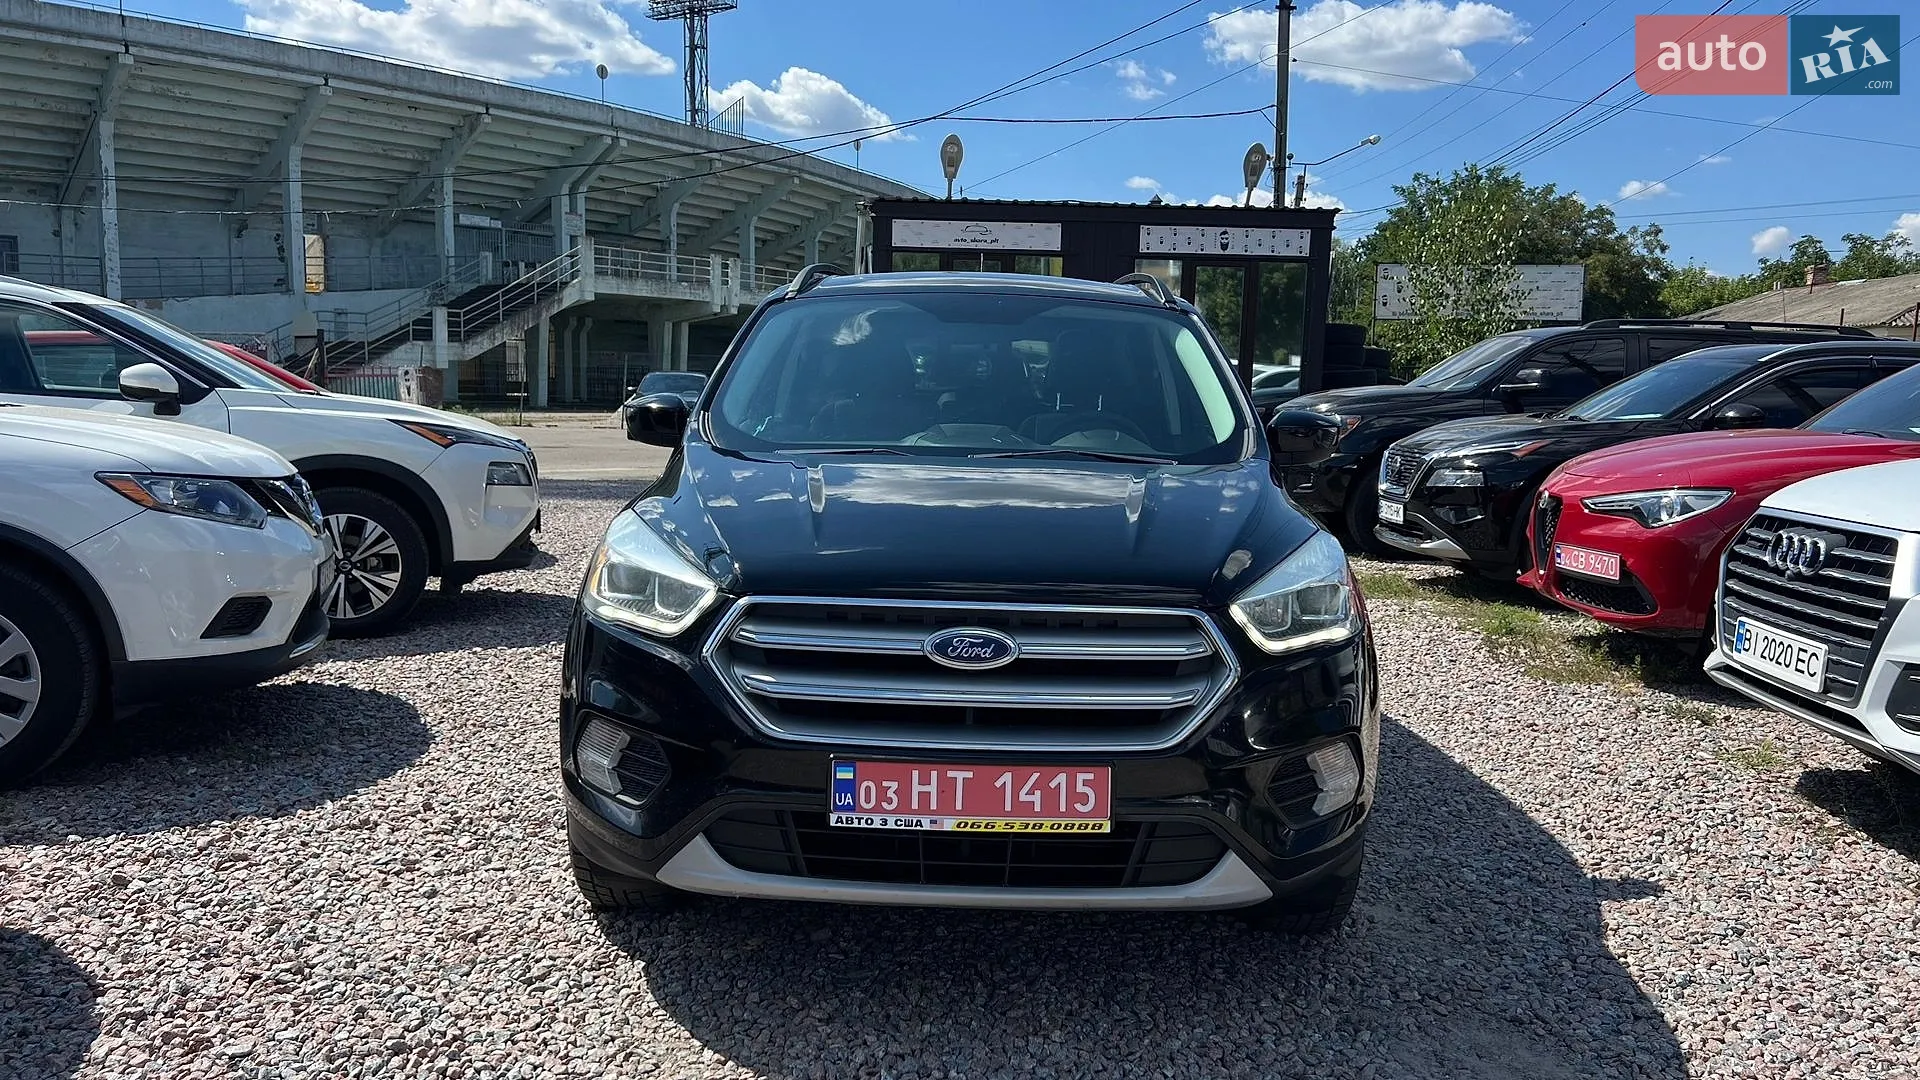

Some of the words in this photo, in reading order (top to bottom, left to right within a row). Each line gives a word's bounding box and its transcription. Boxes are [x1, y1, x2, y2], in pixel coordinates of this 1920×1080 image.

[1571, 551, 1586, 569] CB
[1589, 554, 1615, 575] 9470
[947, 636, 996, 659] Ford
[1743, 628, 1759, 656] BI
[1760, 635, 1793, 669] 2020
[1795, 646, 1819, 678] EC
[835, 793, 853, 806] UA
[859, 780, 899, 811] 03
[911, 769, 974, 811] HT
[993, 771, 1096, 813] 1415
[834, 816, 874, 827] АВТО
[894, 818, 924, 829] США
